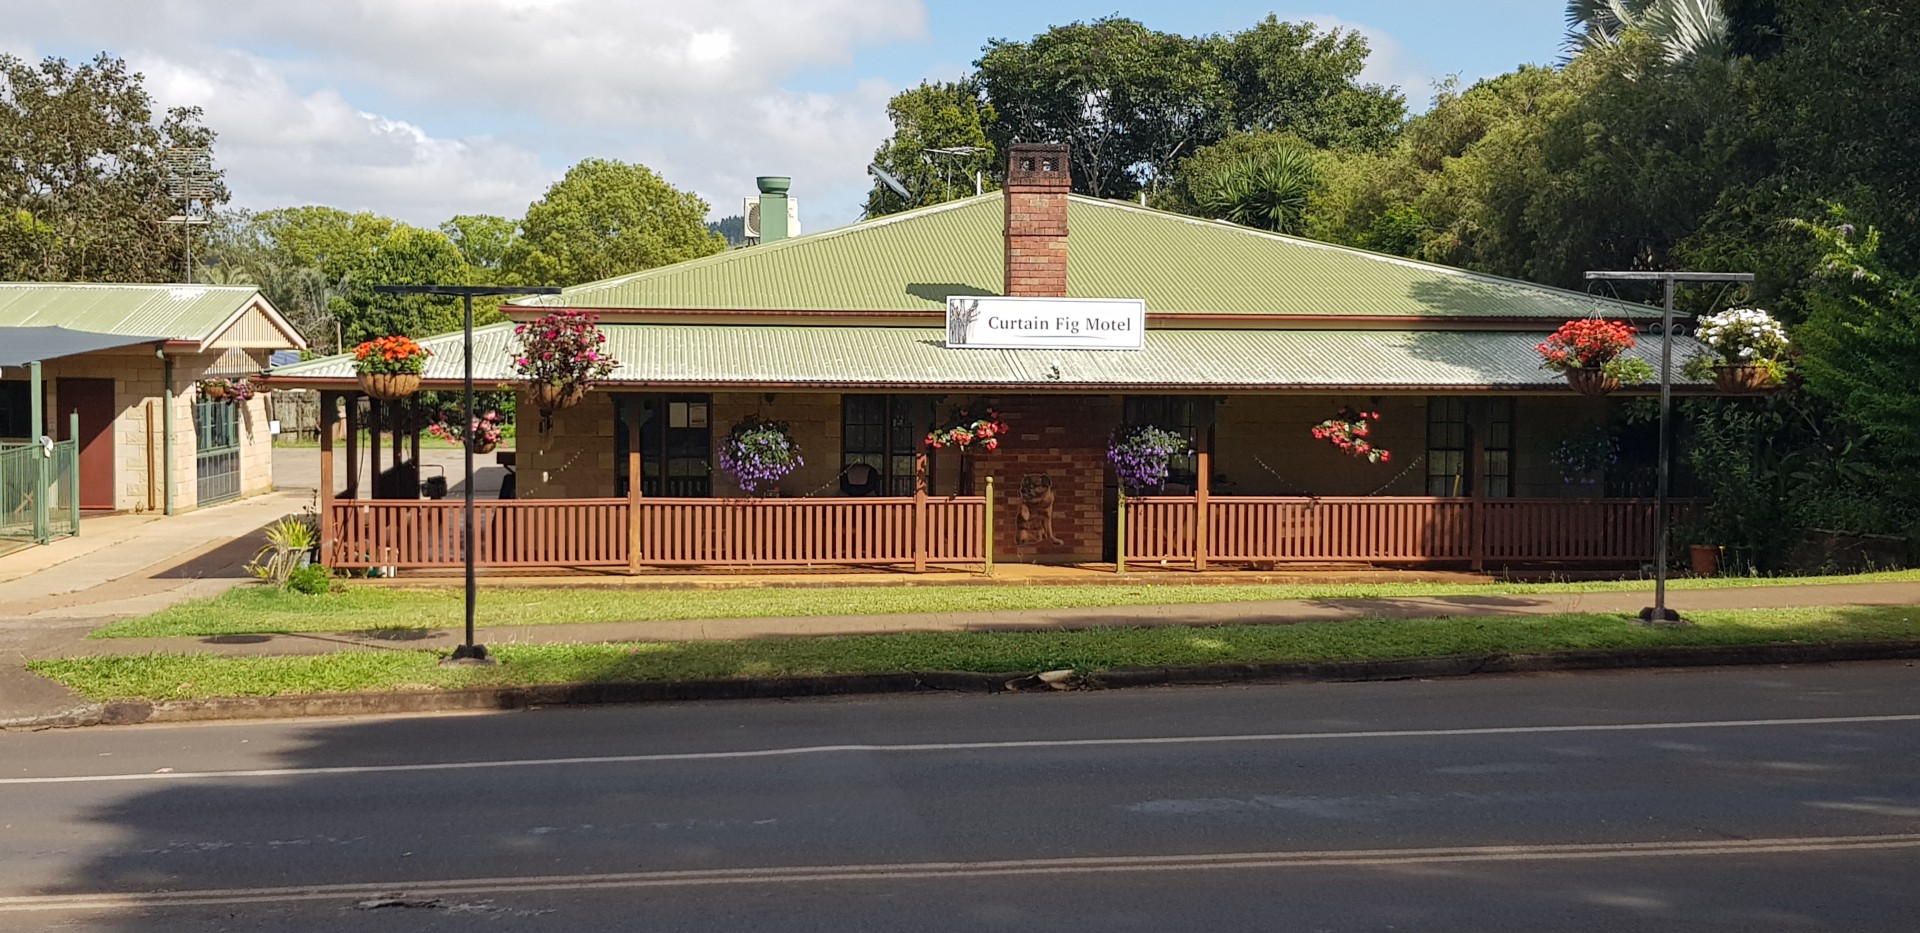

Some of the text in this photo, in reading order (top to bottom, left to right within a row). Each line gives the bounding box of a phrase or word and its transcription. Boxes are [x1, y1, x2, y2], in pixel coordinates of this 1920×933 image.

[988, 316, 1131, 334] Curtain Fig Motel
